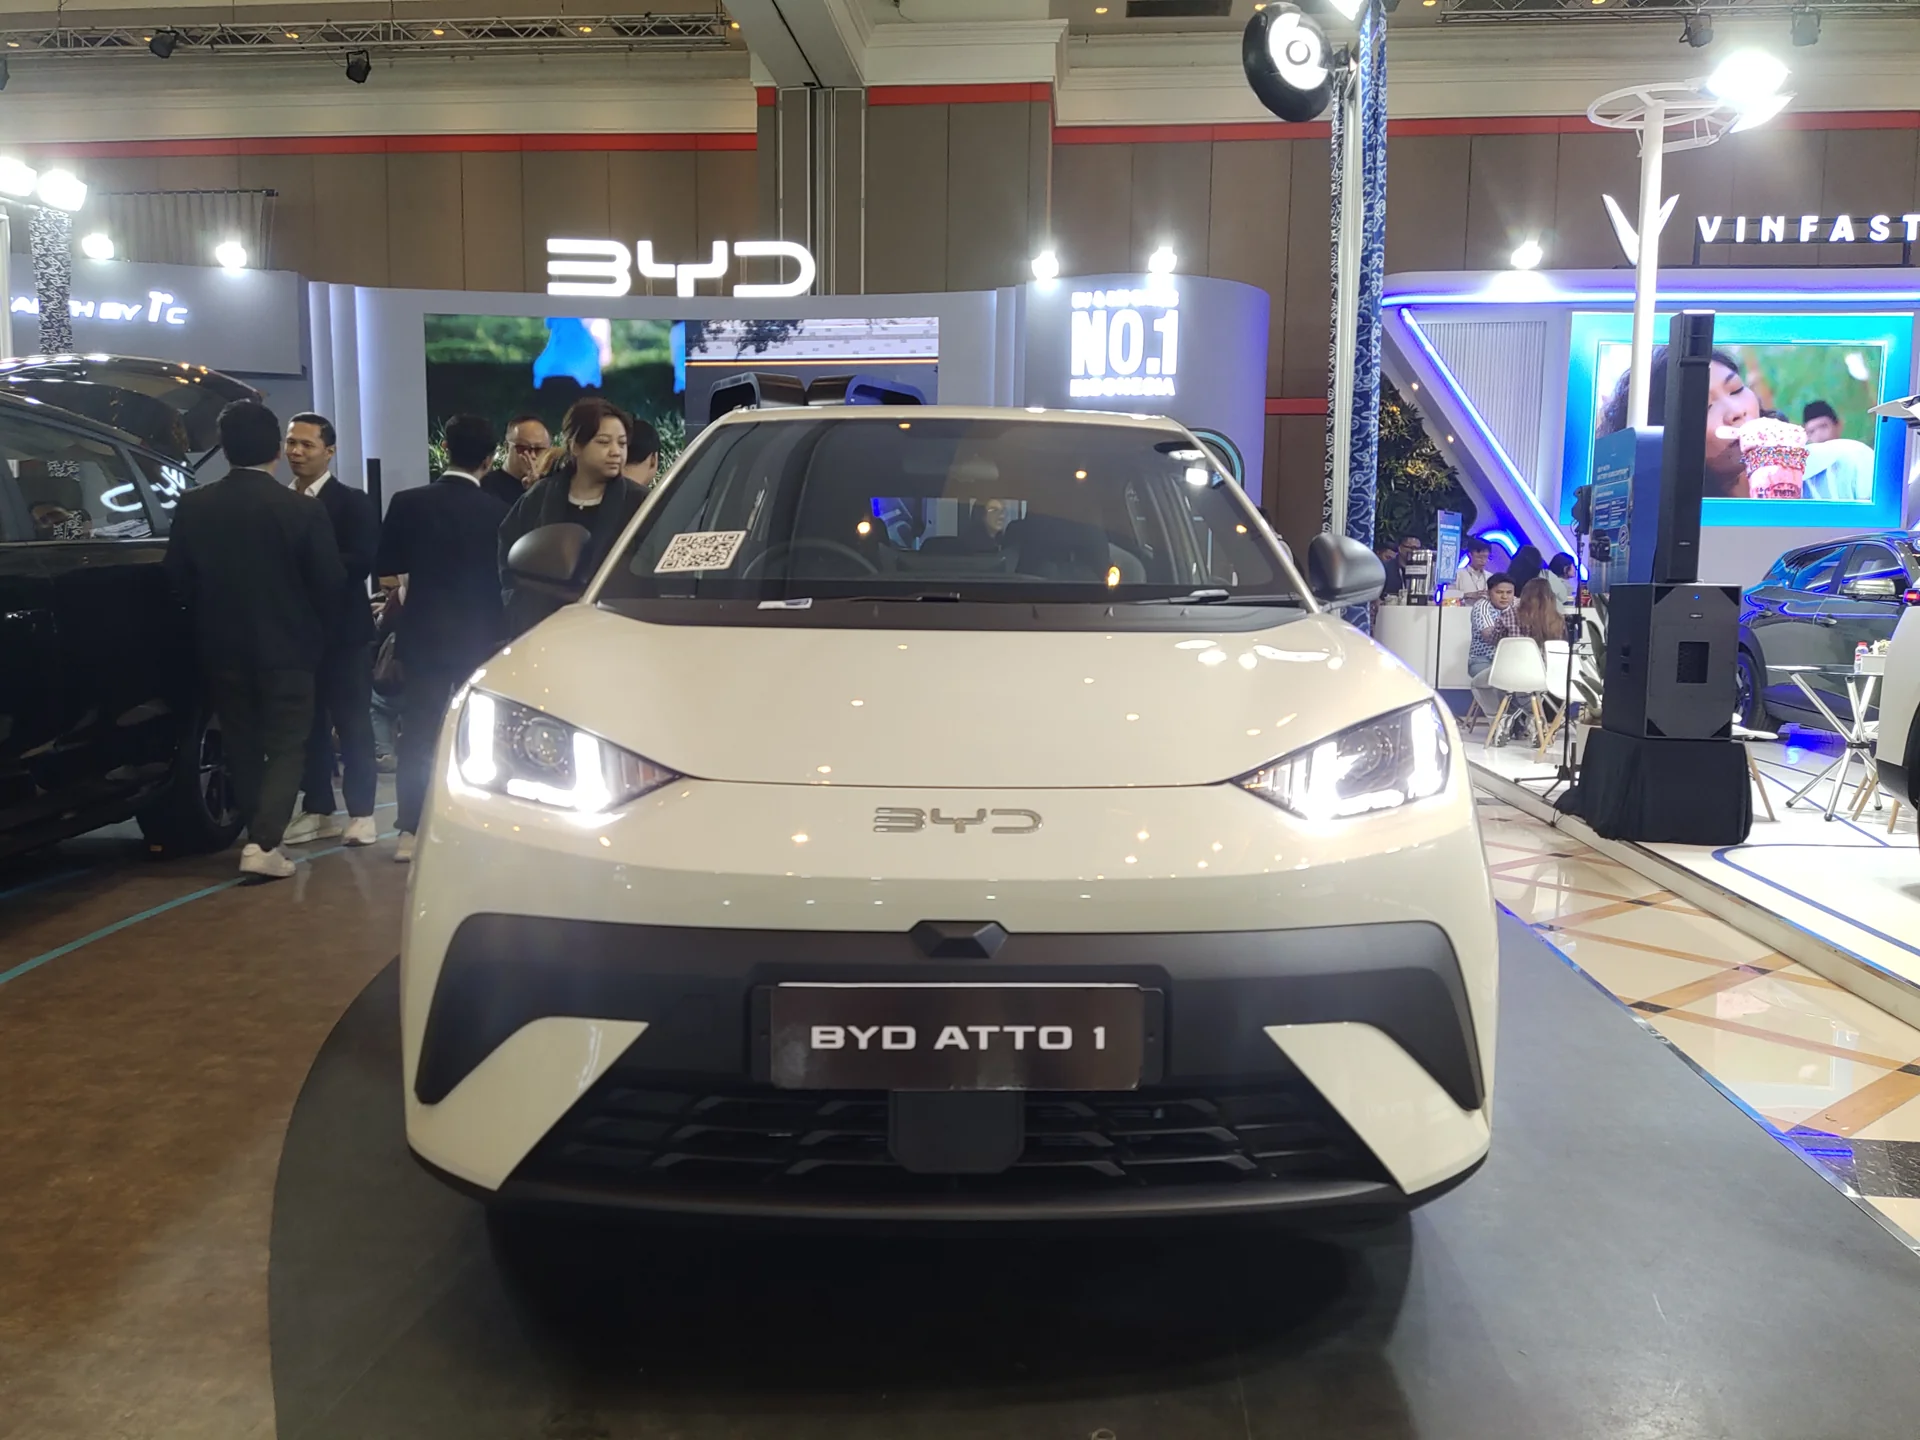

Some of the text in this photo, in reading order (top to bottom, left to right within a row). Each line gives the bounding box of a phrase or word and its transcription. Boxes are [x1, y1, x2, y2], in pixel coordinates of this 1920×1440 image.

[1697, 214, 1920, 243] VINFAST
[546, 238, 816, 298] BYD
[1071, 308, 1179, 376] NO.1
[873, 807, 1044, 834] BYD
[810, 1025, 1106, 1051] BYD ATTO 1
